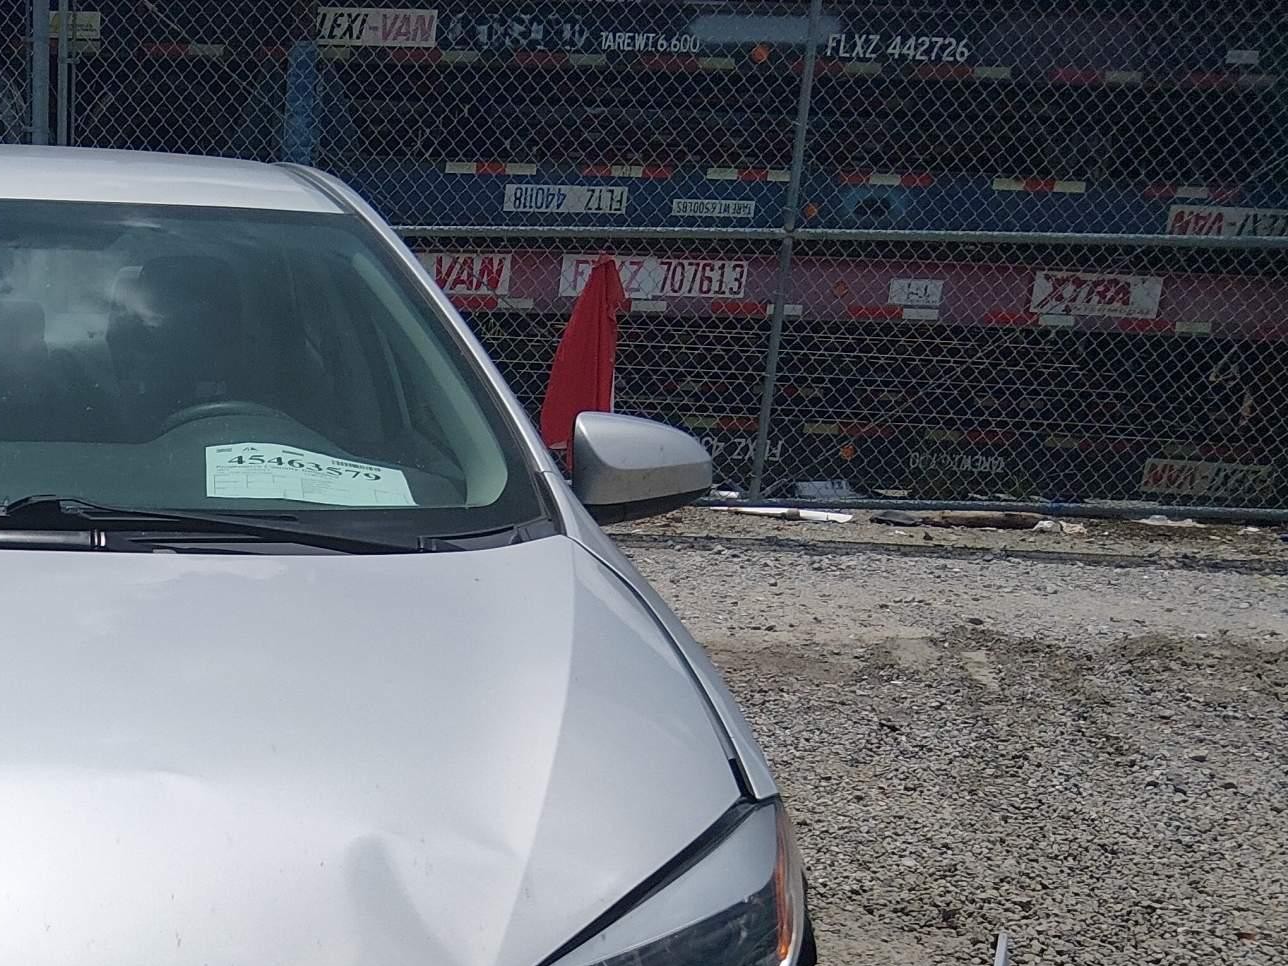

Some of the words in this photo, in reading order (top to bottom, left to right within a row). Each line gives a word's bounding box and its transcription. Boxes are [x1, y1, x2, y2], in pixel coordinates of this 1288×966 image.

[314, 12, 434, 42] LEXI-VAN
[826, 33, 879, 58] FLXZ
[887, 36, 969, 63] 442726
[512, 187, 567, 209] 440118
[585, 188, 624, 211] FLTZ
[434, 255, 505, 292] VAN
[659, 260, 745, 296] 707613
[228, 453, 382, 481] 45463579
